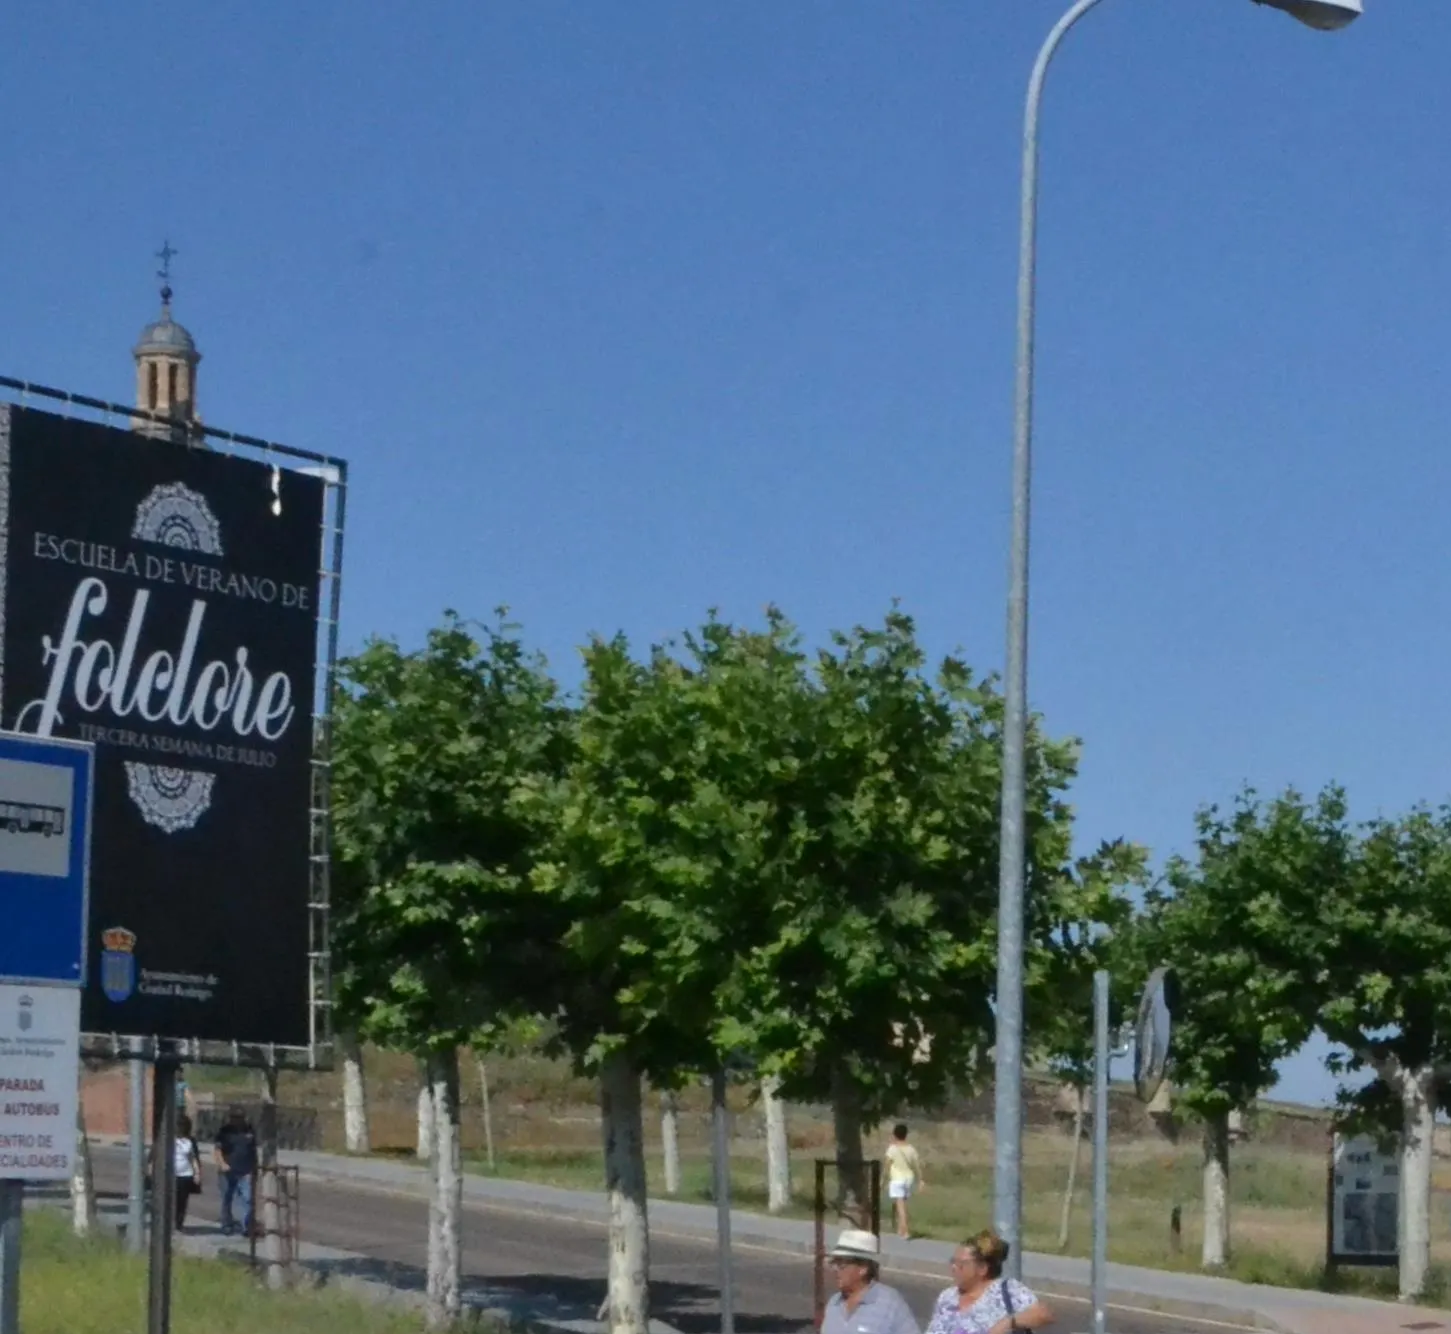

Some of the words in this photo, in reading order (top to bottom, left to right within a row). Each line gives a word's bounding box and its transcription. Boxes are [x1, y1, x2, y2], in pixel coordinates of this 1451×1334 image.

[34, 532, 140, 576] ESCUELA
[145, 555, 176, 584] DE
[180, 561, 277, 603] VERANO
[281, 583, 310, 610] DE
[14, 577, 295, 737] folclore
[78, 723, 149, 750] TERCERA
[151, 735, 215, 758] SEMANA
[216, 743, 237, 762] DE
[237, 747, 278, 768] JULIO
[0, 1078, 45, 1093] PARADA
[4, 1103, 60, 1116] AUTOBUS
[37, 1134, 53, 1149] DE
